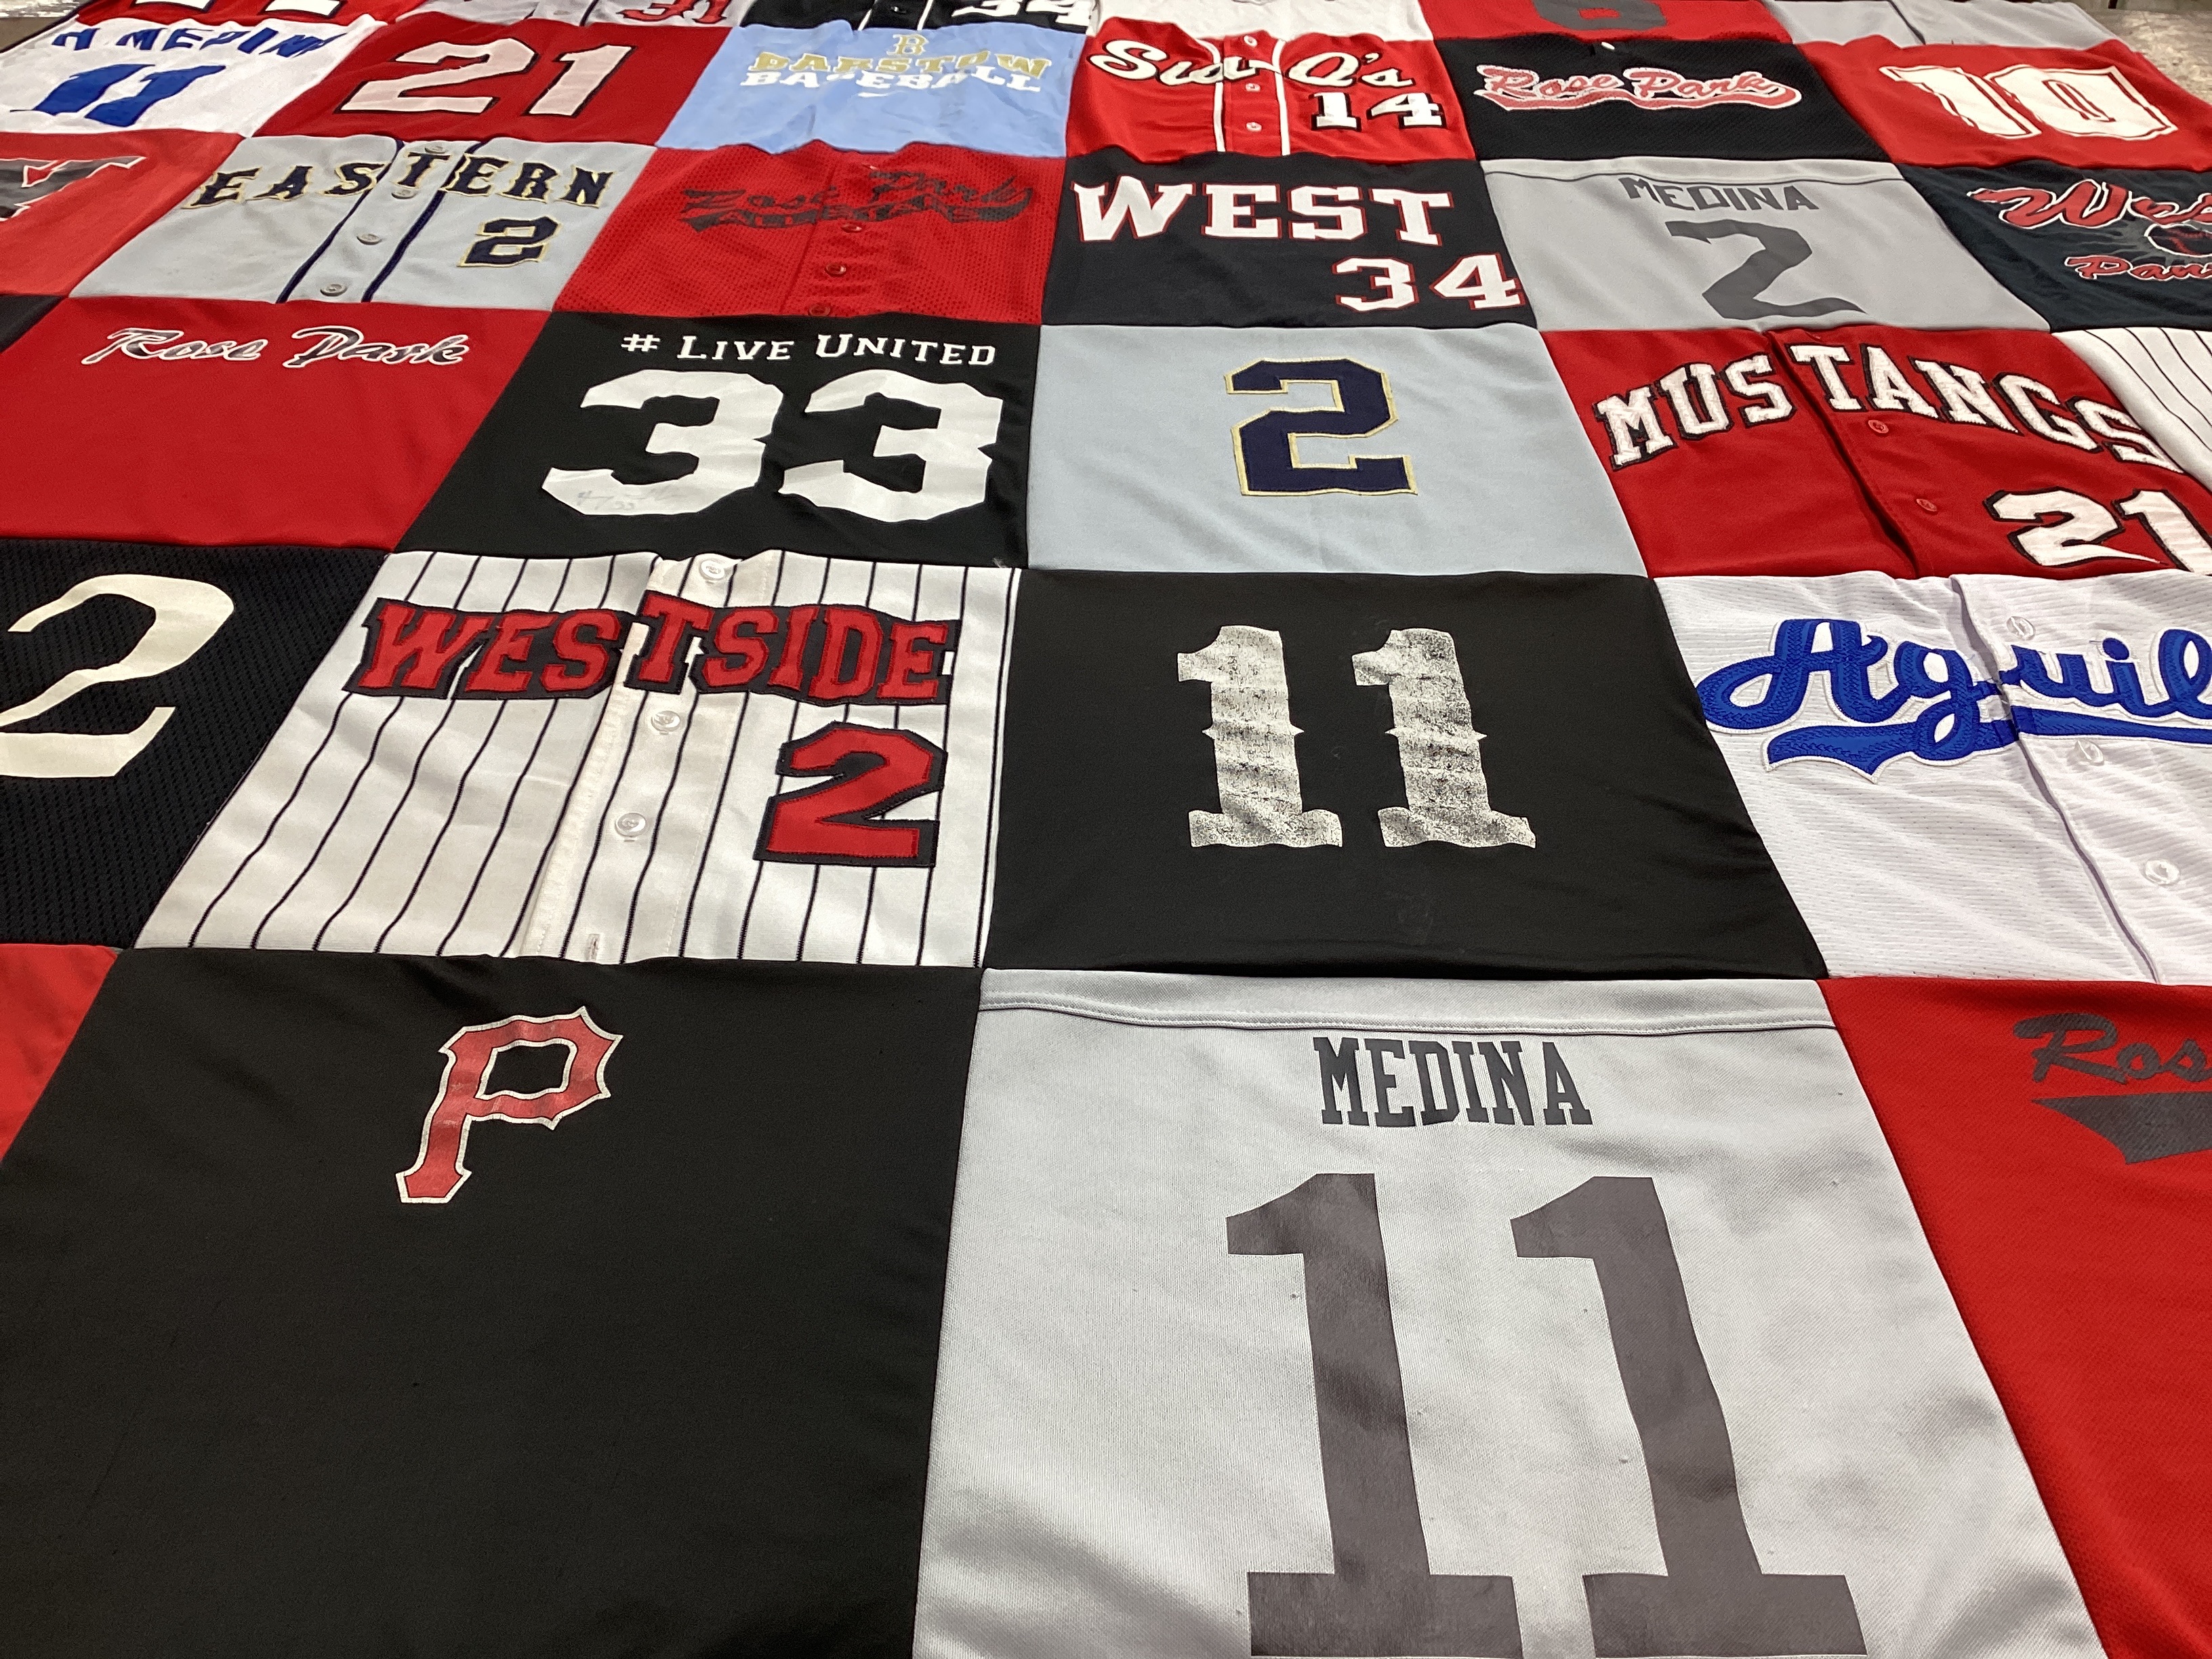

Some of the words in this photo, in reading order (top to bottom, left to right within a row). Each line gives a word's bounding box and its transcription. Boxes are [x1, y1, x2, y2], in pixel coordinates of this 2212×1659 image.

[335, 37, 634, 117] 21
[748, 49, 1052, 79] BARSTOW
[886, 33, 929, 56] B
[1476, 66, 1624, 99] Rose
[1622, 68, 1770, 99] Park
[1309, 91, 1443, 130] 14
[1879, 64, 2178, 140] 10
[181, 152, 614, 209] EASTERN
[1073, 176, 1454, 245] WEST
[1618, 178, 1820, 211] MEDINA
[457, 217, 561, 268] 2
[1332, 253, 1521, 312] 34
[1665, 219, 1868, 320] 2
[81, 327, 268, 365] Rose
[282, 325, 470, 368] Park
[541, 369, 1004, 523] 33
[1224, 356, 1418, 496] 2
[1594, 344, 2184, 473] MUSTANGS
[1983, 488, 2212, 576] 21
[0, 574, 234, 778] 2
[342, 589, 961, 706] WESTSIDE
[1177, 625, 1536, 848] 11
[752, 720, 948, 867] 2
[1313, 1037, 1594, 1128] MEDINA
[2013, 1012, 2212, 1084] Ros
[395, 1006, 623, 1204] P
[1225, 1173, 1868, 1659] 11
